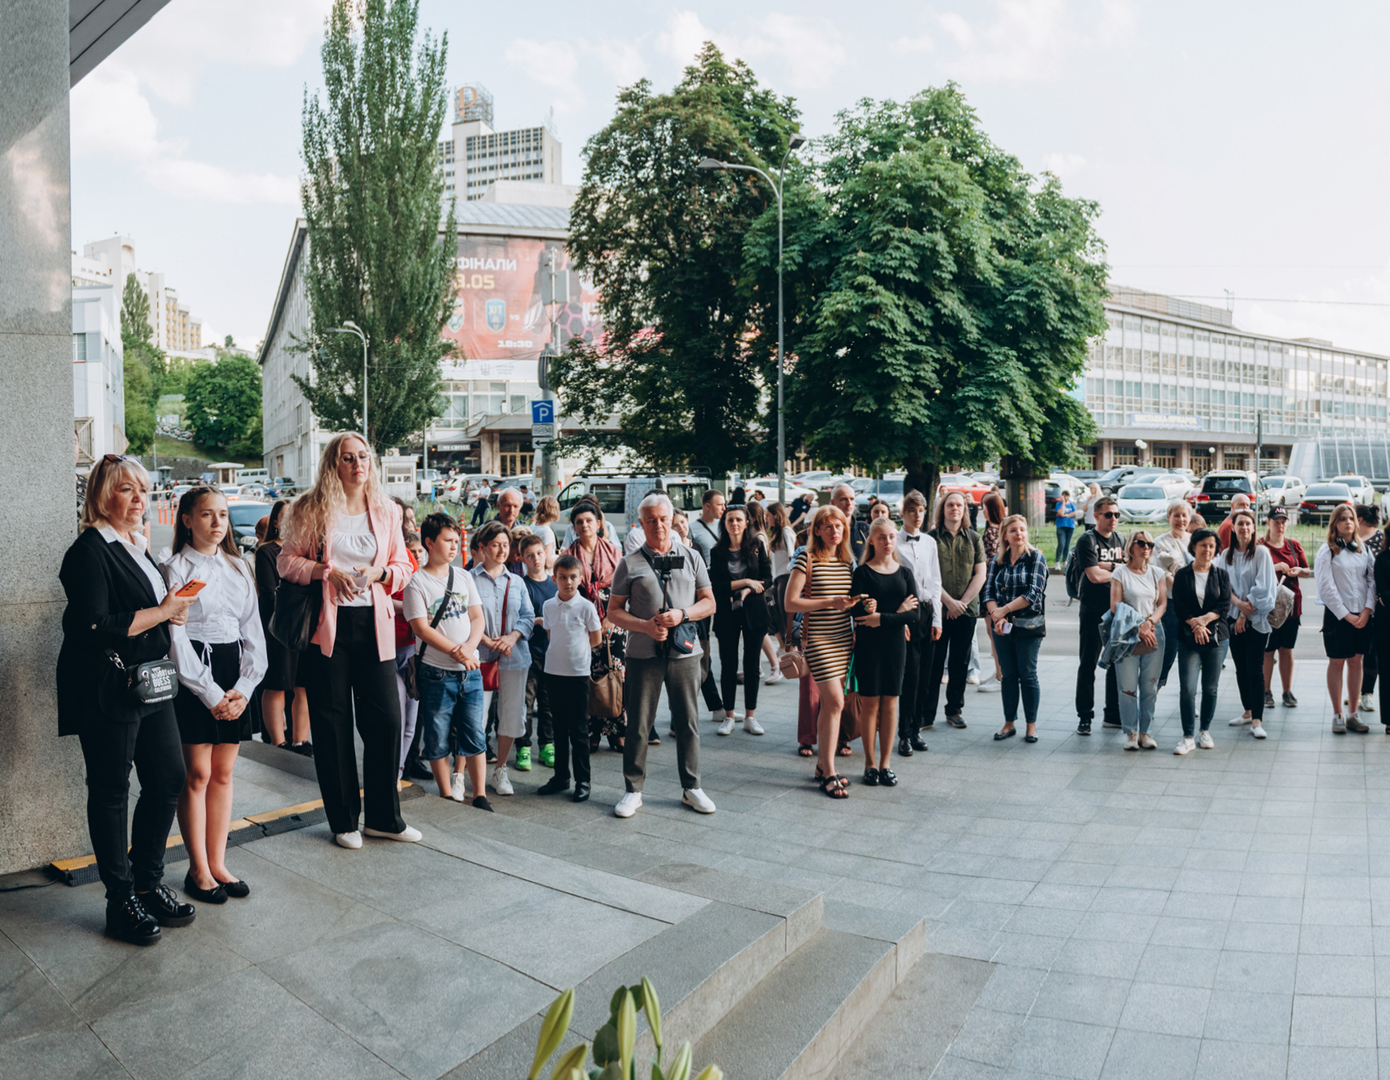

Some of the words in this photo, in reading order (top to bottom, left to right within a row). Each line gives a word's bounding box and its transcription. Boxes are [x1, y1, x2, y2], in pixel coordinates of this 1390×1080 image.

[497, 340, 533, 348] 18:30
[540, 407, 549, 421] P
[152, 675, 172, 688] GUESS
